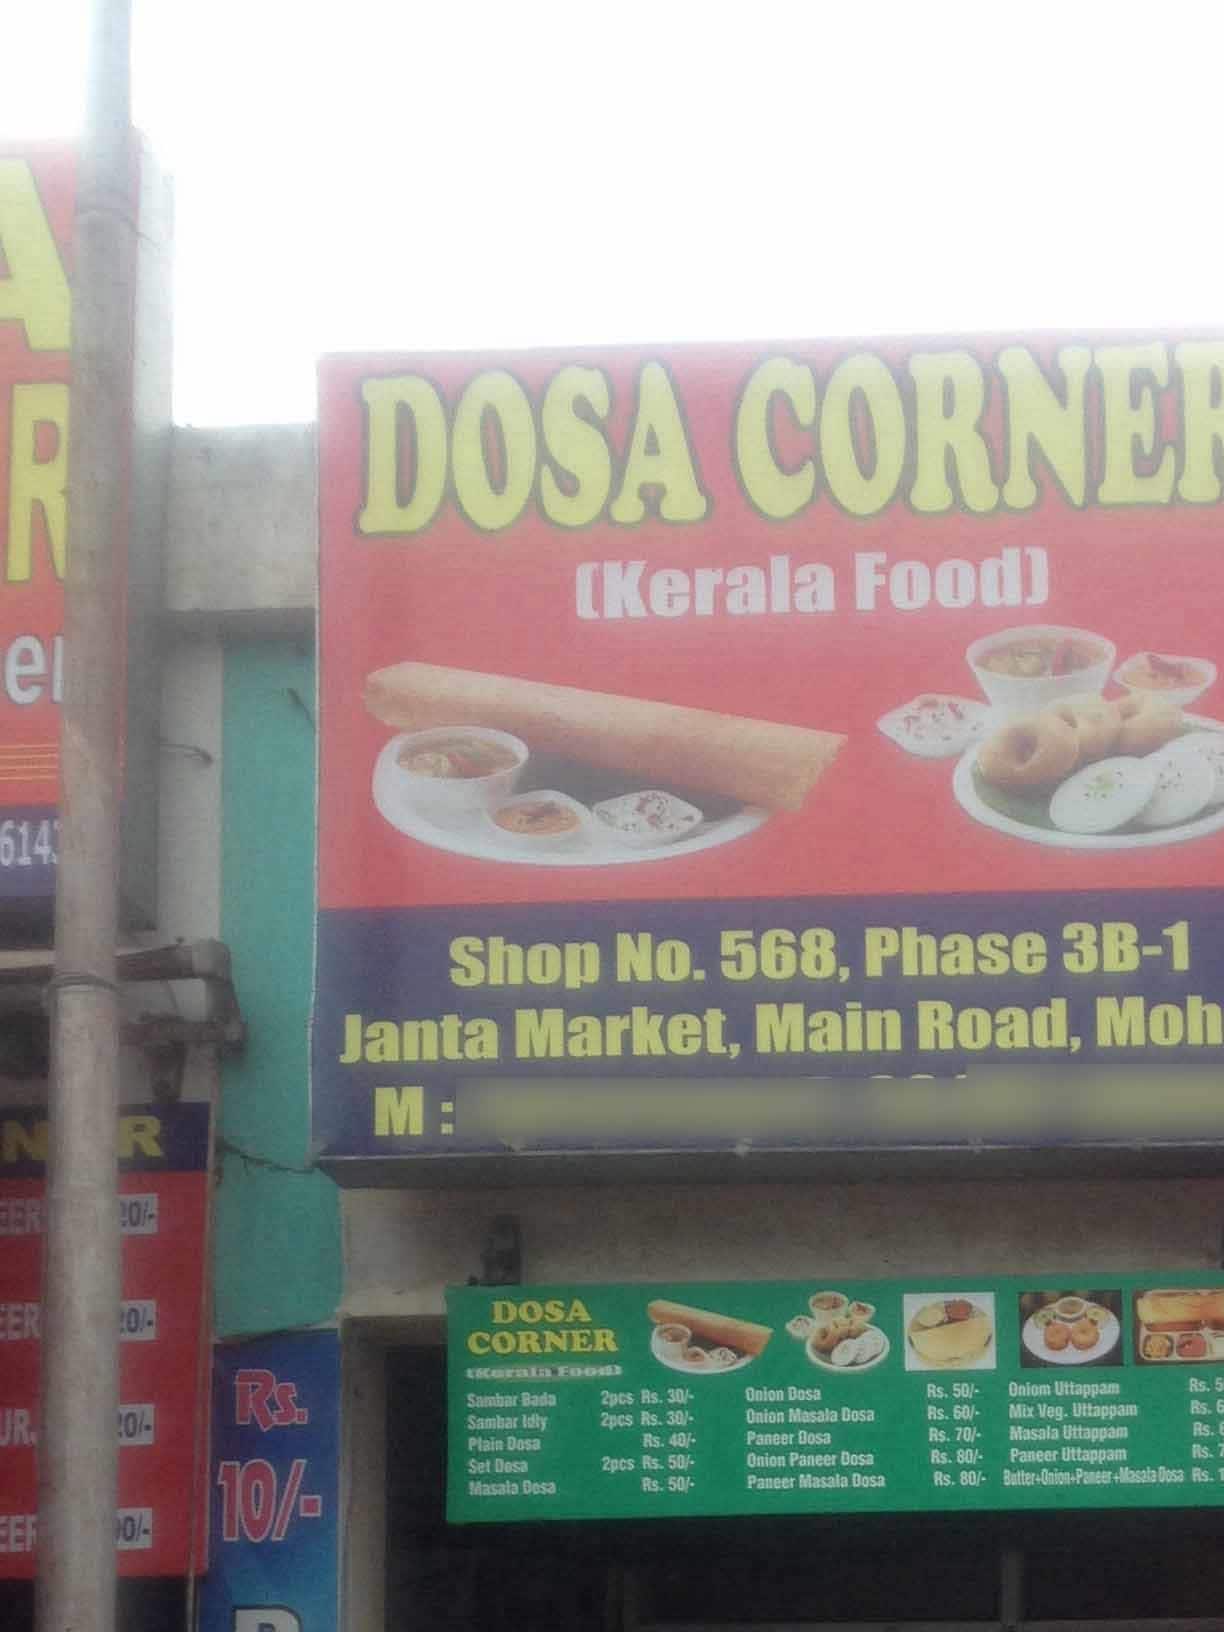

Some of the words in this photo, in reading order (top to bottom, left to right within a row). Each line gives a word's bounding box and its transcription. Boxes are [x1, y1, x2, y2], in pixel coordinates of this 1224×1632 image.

[355, 358, 712, 537] DOSA
[574, 555, 836, 620] (Kerala
[854, 546, 1049, 611] Food)
[449, 936, 600, 989] Shop
[615, 931, 706, 983] No.
[720, 927, 850, 983] 568,
[865, 925, 1048, 977] Phase
[1062, 920, 1190, 974] 3B-1
[339, 1013, 499, 1064] Janta
[515, 1005, 742, 1060] Market,
[756, 1001, 902, 1053] Main
[917, 997, 1082, 1054] Road,
[491, 1298, 592, 1324] DOSA
[467, 1328, 619, 1356] CORNER
[745, 1386, 784, 1401] Onion
[788, 1386, 821, 1401] Dosa
[926, 1383, 949, 1399] Rs.
[1054, 1380, 1120, 1398] Uttappam
[1189, 1377, 1210, 1393] Rs.
[234, 1368, 309, 1432] Rs.
[467, 1392, 518, 1408] Sambar
[600, 1389, 635, 1407] 2pcs
[640, 1388, 664, 1404] Rs.
[746, 1409, 784, 1424] Onion
[788, 1408, 838, 1423] Masala
[841, 1407, 874, 1422] Dosa
[927, 1405, 949, 1421] Rs.
[1008, 1403, 1034, 1419] Mix
[1037, 1403, 1069, 1421] Veg.
[1072, 1402, 1138, 1420] Uttappam
[1190, 1399, 1212, 1415] Rs.
[467, 1415, 517, 1430] Sambar
[522, 1413, 548, 1432] Idly
[600, 1412, 634, 1430] 2pcs
[640, 1411, 663, 1427] Rs.
[747, 1430, 794, 1446] Paneer
[798, 1430, 832, 1445] Dosa
[928, 1427, 950, 1443] Rs.
[1009, 1425, 1060, 1441] Masala
[1062, 1424, 1129, 1442] Uttappam
[1192, 1422, 1215, 1437] Rs.
[467, 1437, 504, 1452] Plain
[506, 1436, 541, 1451] Dosa
[642, 1433, 665, 1448] Rs.
[747, 1452, 786, 1468] Onion
[789, 1451, 837, 1467] Paneer
[840, 1451, 874, 1466] Dosa
[930, 1449, 953, 1465] Rs.
[1010, 1447, 1058, 1463] Paneer
[1061, 1446, 1128, 1464] Uttappam
[1191, 1444, 1214, 1460] Rs.
[468, 1458, 493, 1474] Set
[495, 1458, 528, 1473] Dosa
[601, 1456, 635, 1473] 2pcs
[642, 1455, 664, 1470] Rs.
[1159, 1466, 1184, 1483] Dosa
[1191, 1467, 1214, 1483] Rs.
[468, 1480, 519, 1496] Masala
[522, 1479, 556, 1495] Dosa
[641, 1477, 663, 1492] Rs.
[747, 1474, 794, 1490] Paneer
[799, 1473, 849, 1489] Masala
[852, 1472, 886, 1488] Dosa
[933, 1471, 956, 1487] Rs.
[216, 1458, 322, 1543] 10/-
